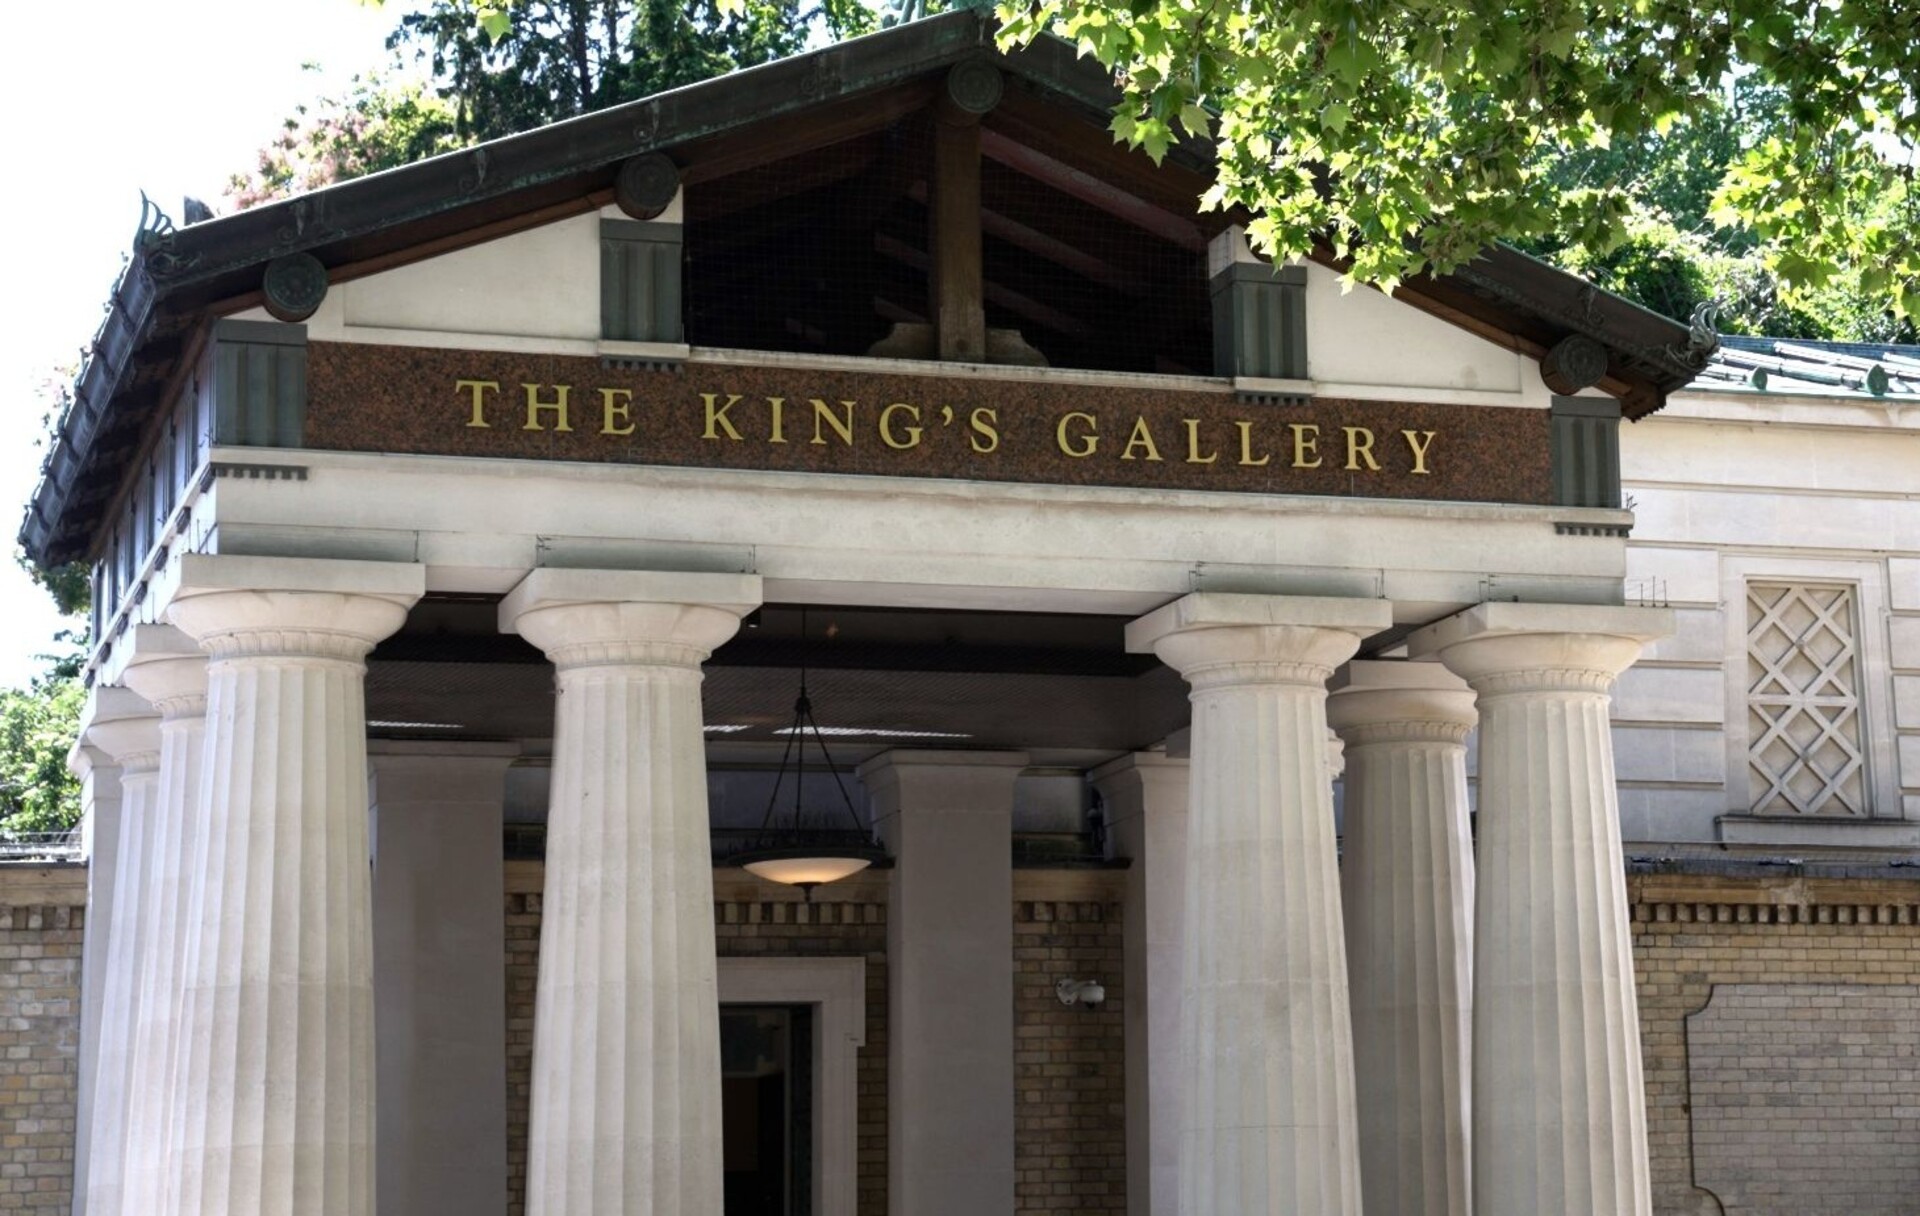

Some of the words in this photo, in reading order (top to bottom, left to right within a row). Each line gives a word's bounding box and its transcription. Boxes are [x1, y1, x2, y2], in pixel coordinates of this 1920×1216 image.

[455, 379, 636, 435] THE
[699, 392, 999, 454] KING'S
[1056, 411, 1437, 476] GALLERY
